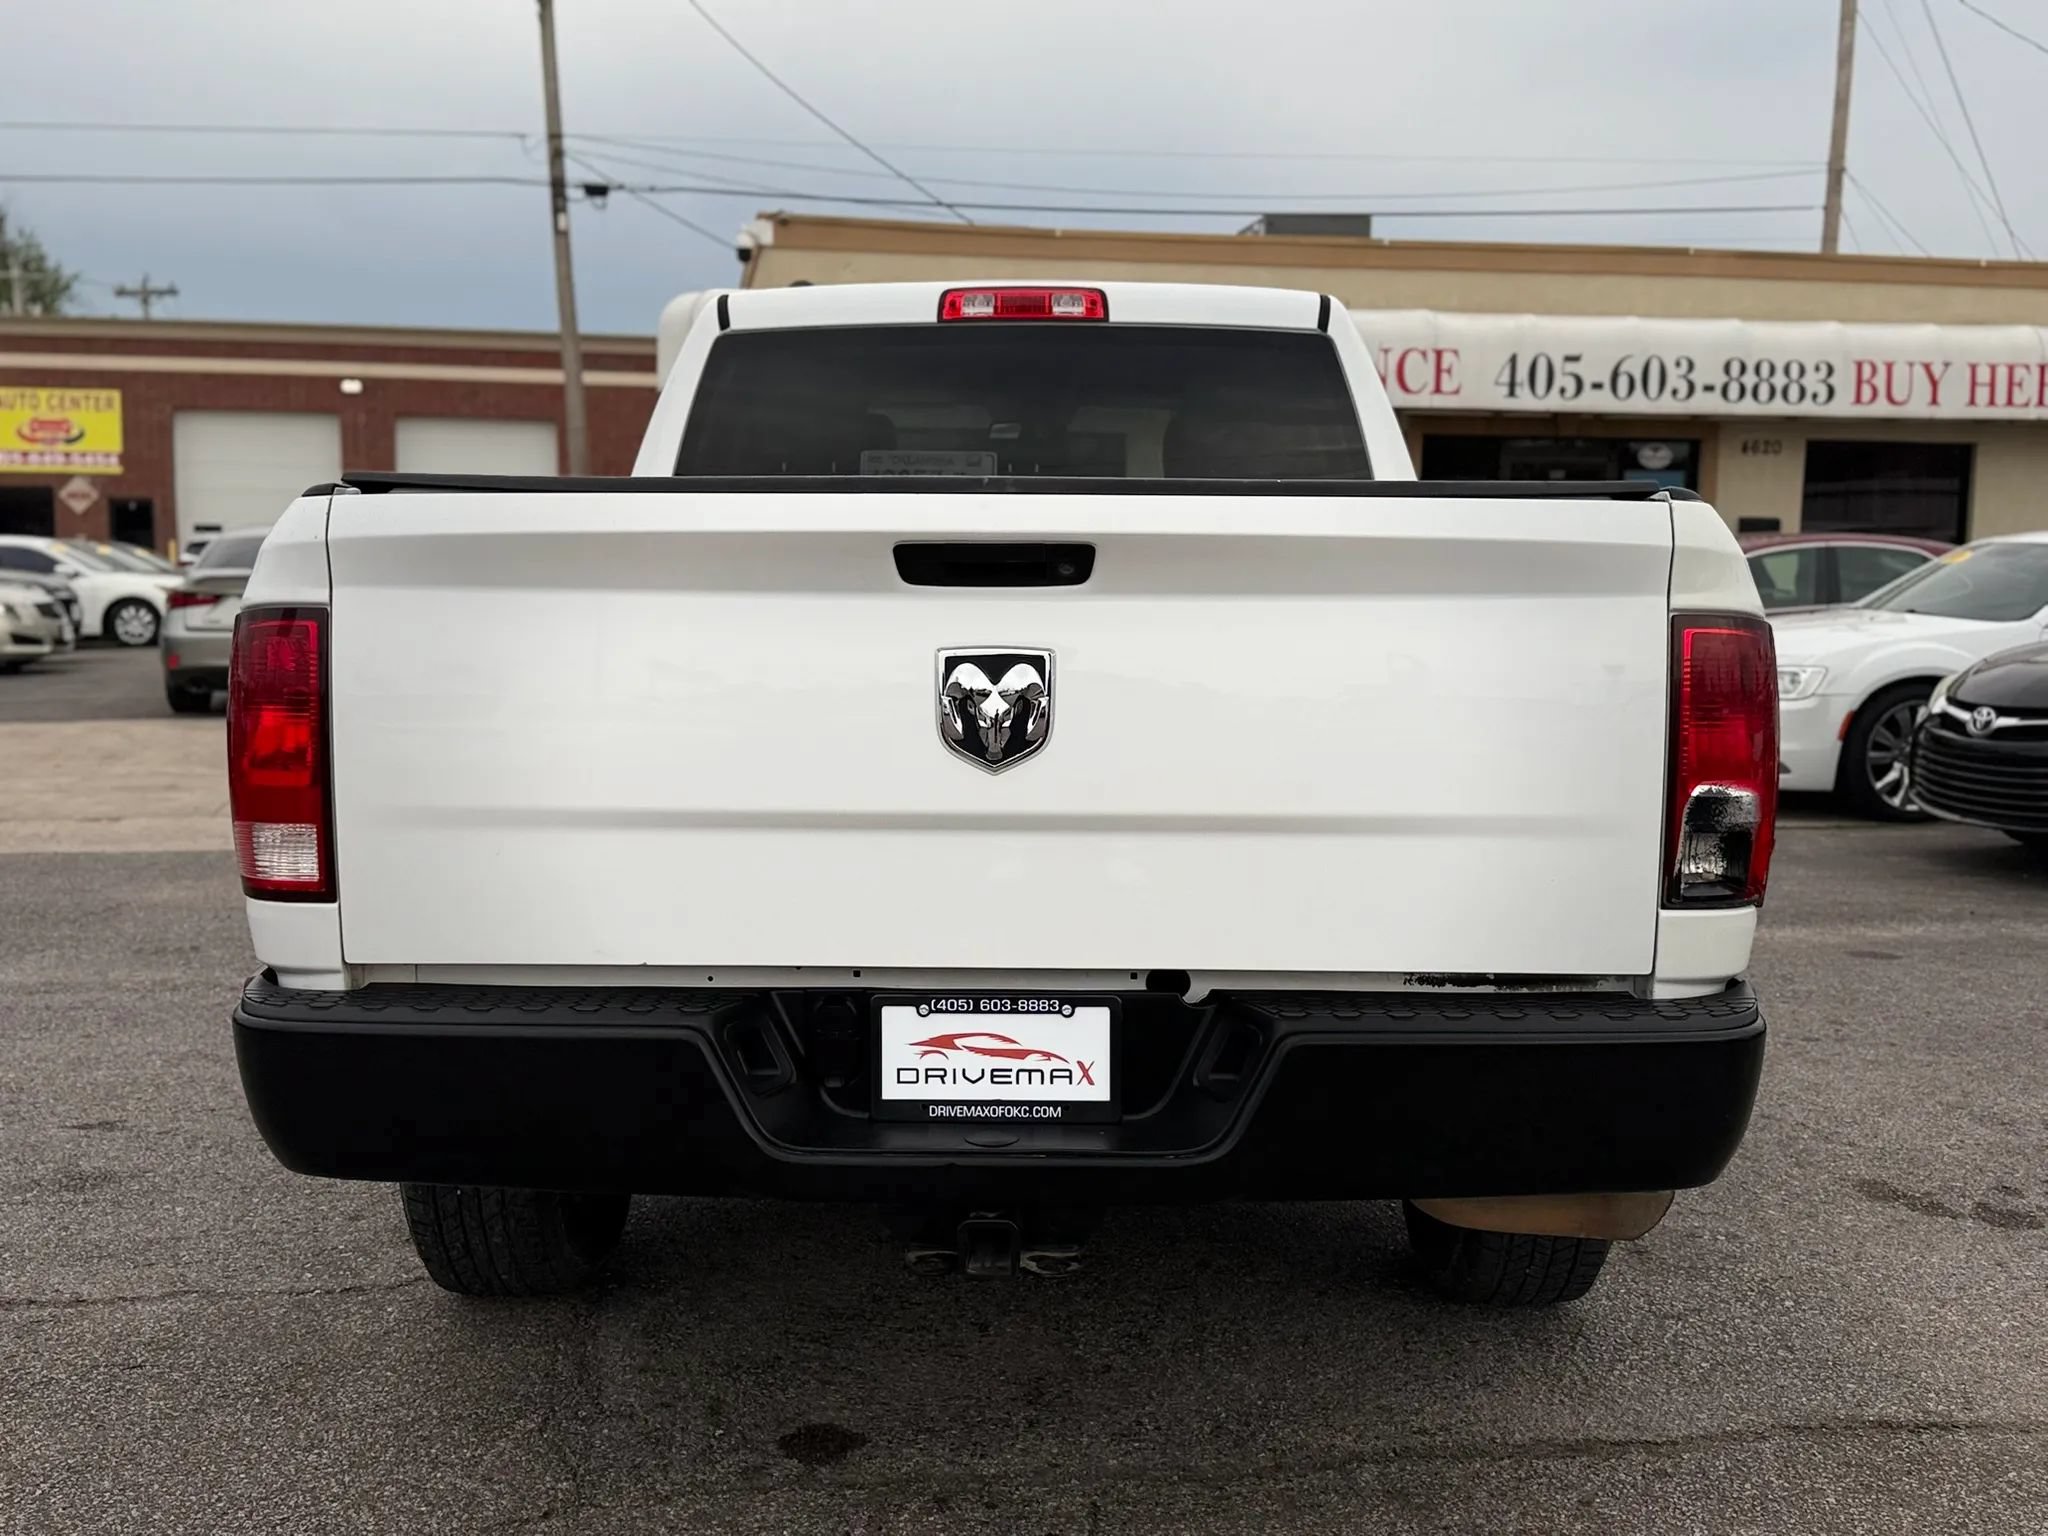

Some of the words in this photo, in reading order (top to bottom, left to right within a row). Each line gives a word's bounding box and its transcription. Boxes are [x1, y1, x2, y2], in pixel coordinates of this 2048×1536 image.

[1494, 351, 1836, 406] 405-603-8883
[1850, 359, 1952, 407] BUY
[47, 392, 115, 413] CENTER
[930, 999, 974, 1012] (405)
[980, 999, 1060, 1012] 603-8883
[896, 1060, 1095, 1086] DRIVEMAX
[929, 1105, 1062, 1118] DRIVEMAXOFOKC.COM
